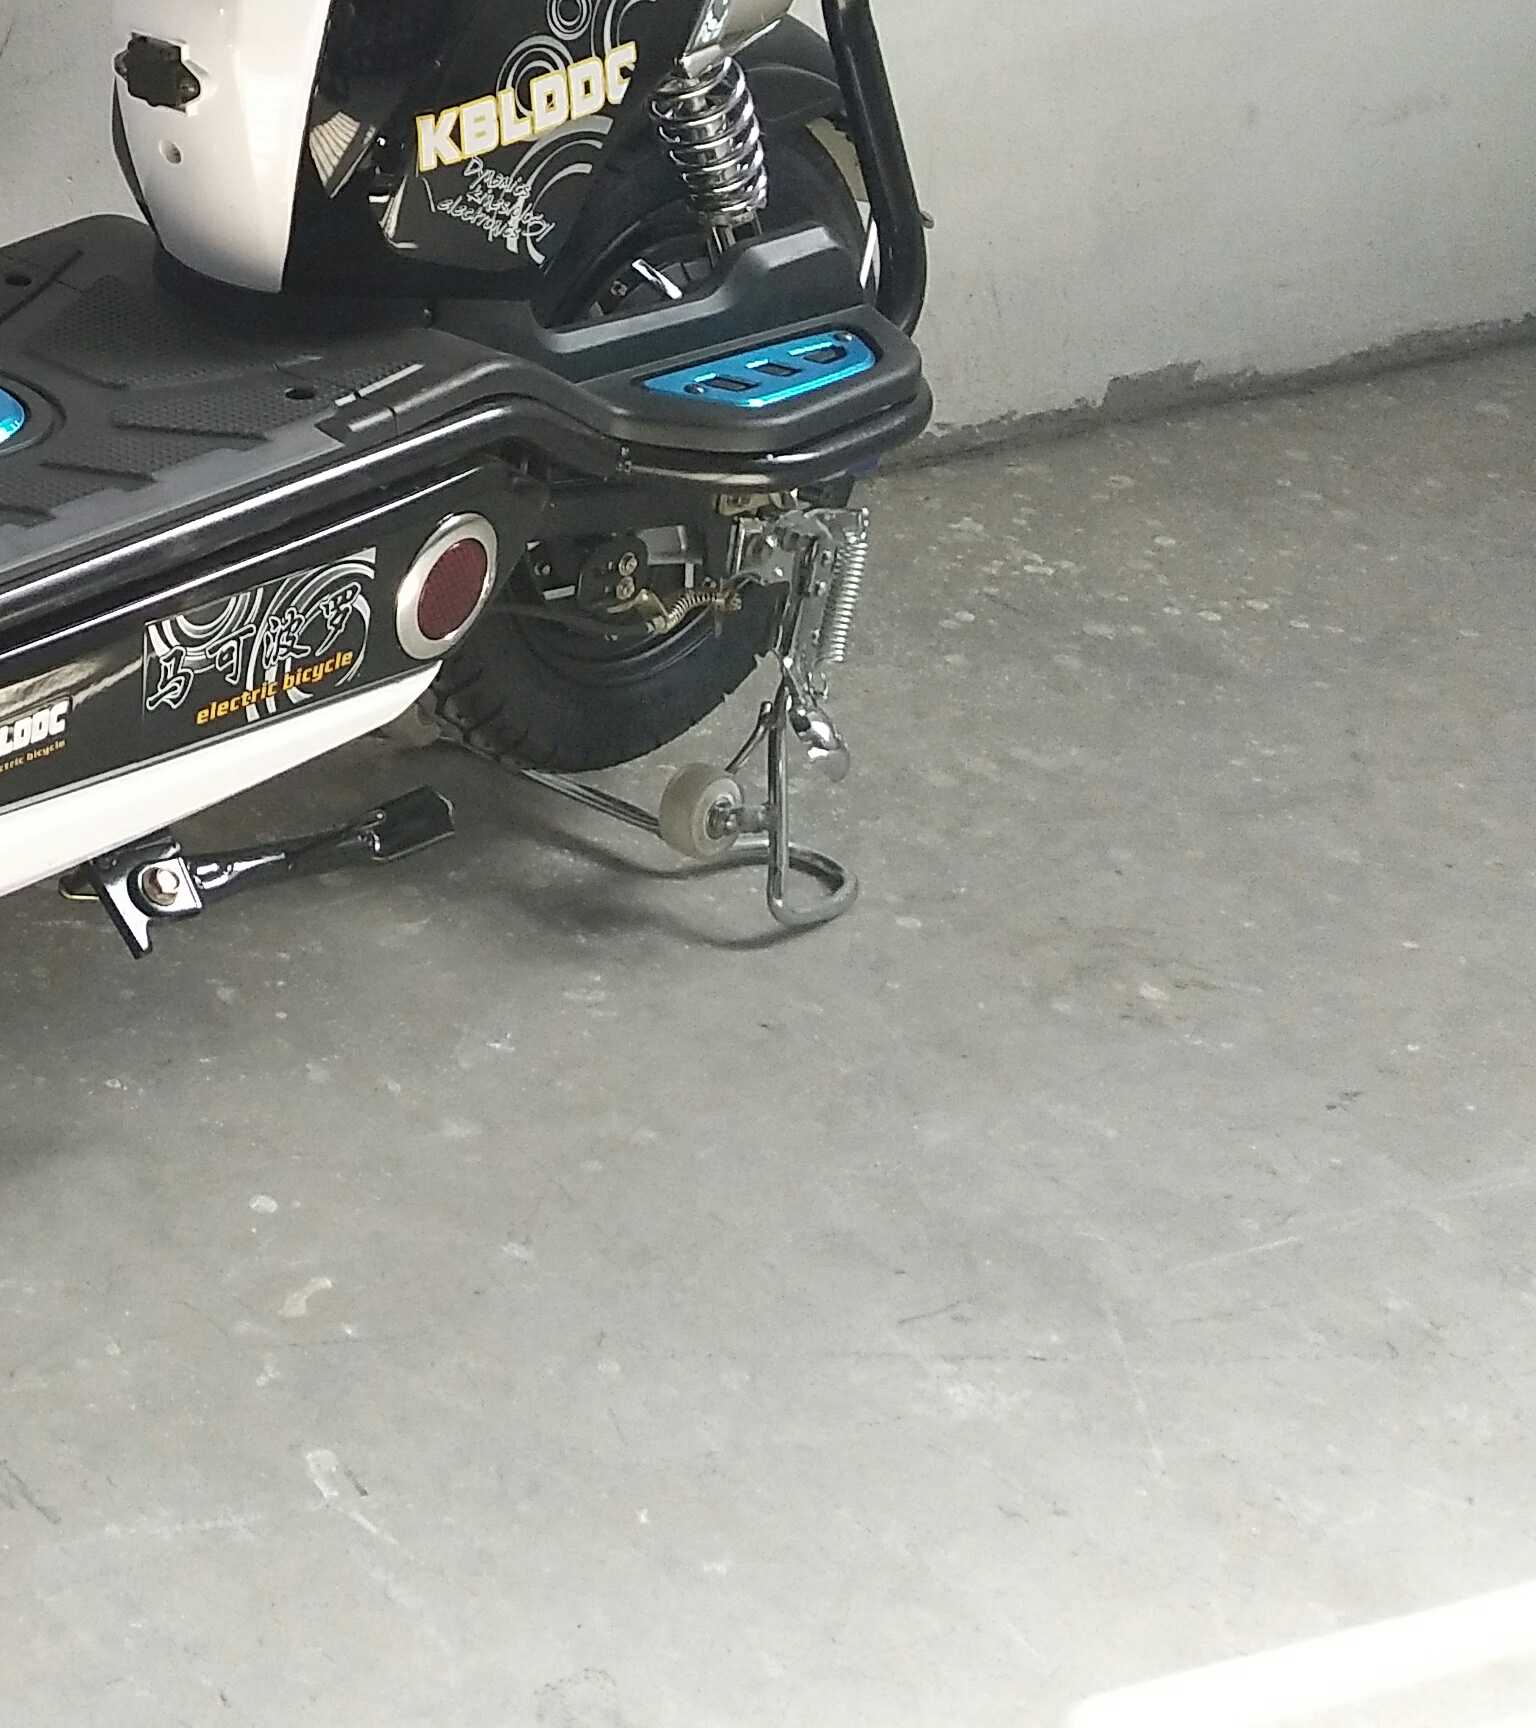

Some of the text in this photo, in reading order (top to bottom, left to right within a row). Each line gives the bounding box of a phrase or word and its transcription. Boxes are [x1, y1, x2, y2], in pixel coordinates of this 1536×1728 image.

[145, 581, 362, 711] 马可波罗
[195, 649, 354, 725] electric bicycle
[26, 739, 66, 763] bicycle
